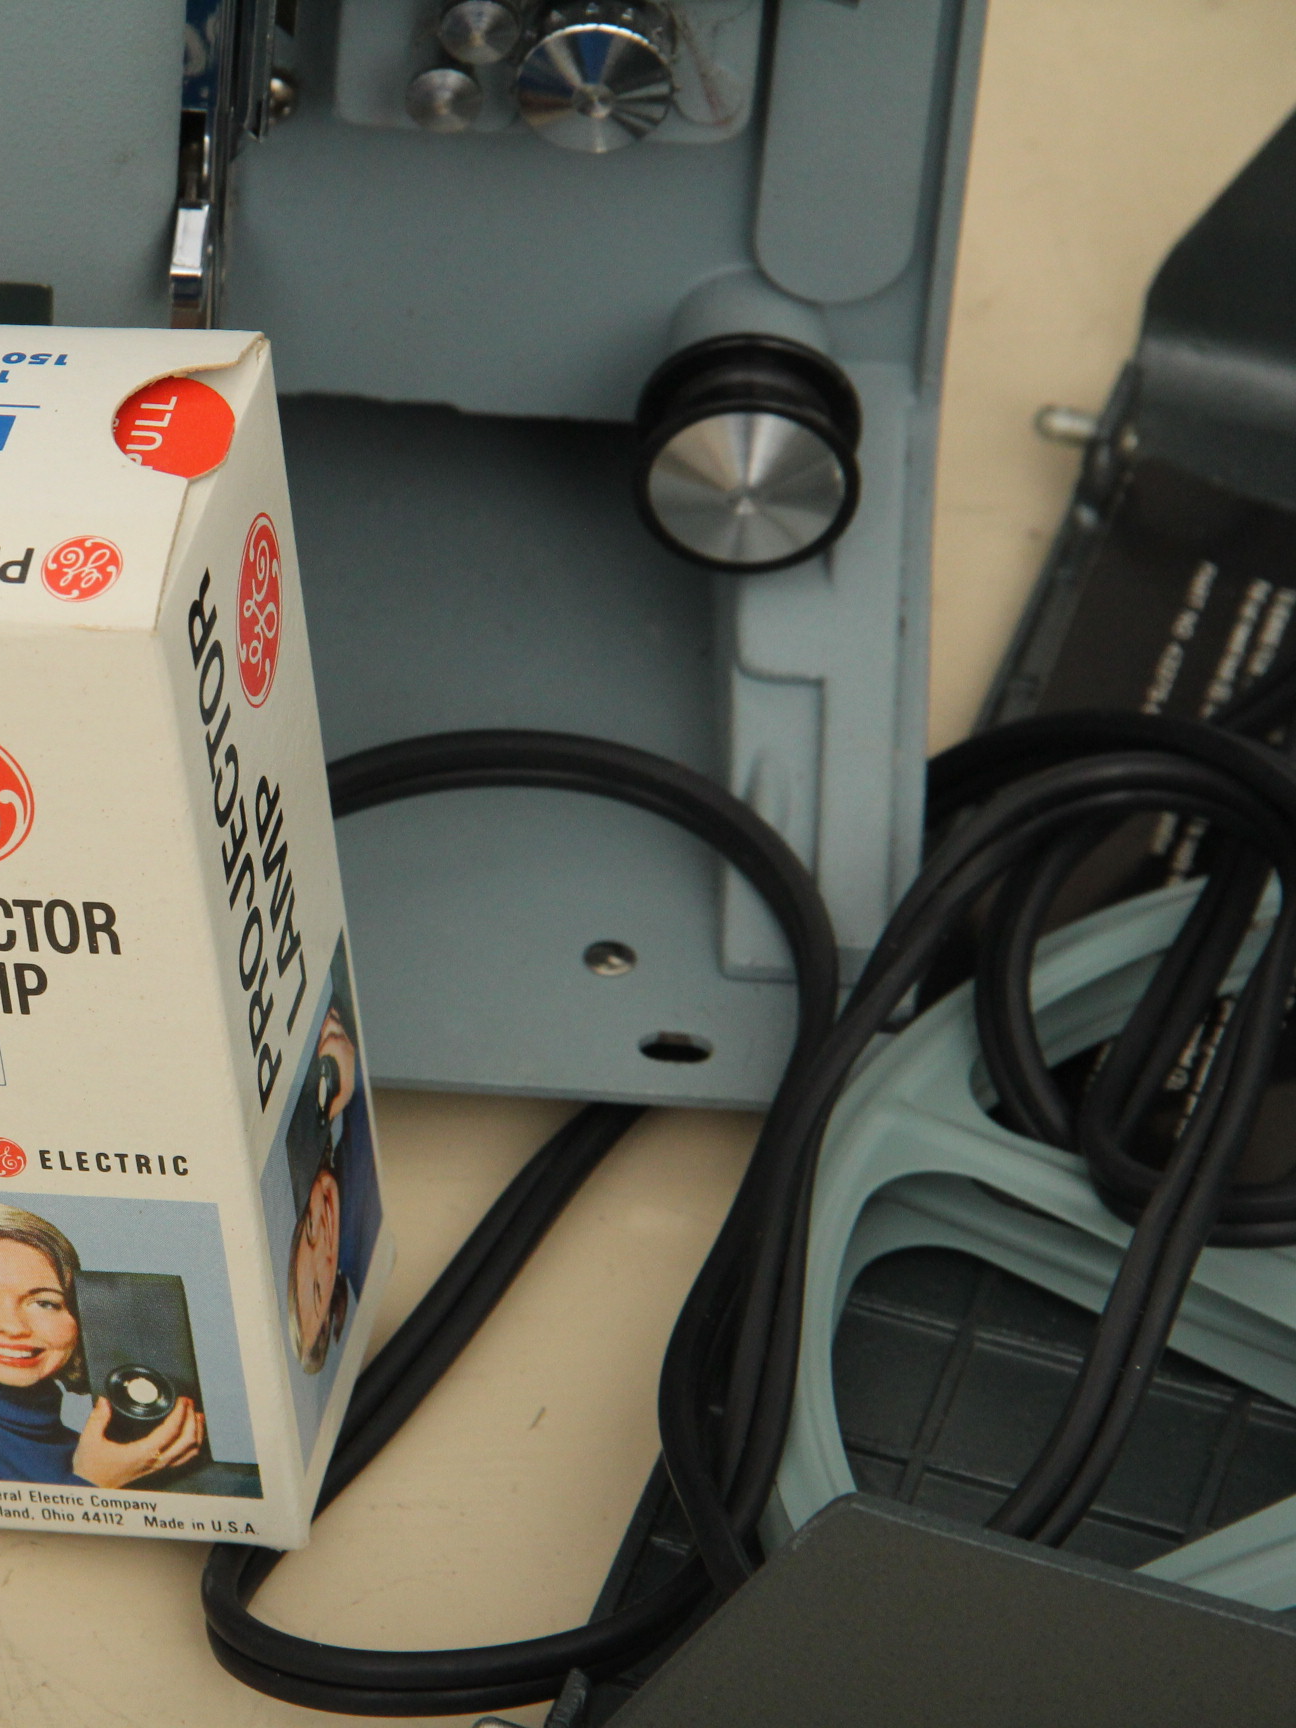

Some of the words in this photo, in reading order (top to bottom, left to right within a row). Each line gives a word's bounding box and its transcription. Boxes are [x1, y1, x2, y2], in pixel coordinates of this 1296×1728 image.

[1, 352, 69, 366] 150
[188, 570, 282, 1113] PROJECTOR
[254, 775, 307, 1036] LAMP
[38, 1149, 190, 1177] ELECTRIC
[28, 1489, 85, 1507] Electric
[90, 1495, 158, 1512] Company
[41, 1508, 76, 1523] Ohio
[81, 1510, 125, 1526] 44112
[143, 1515, 186, 1530] Made
[191, 1519, 206, 1532] in
[211, 1520, 261, 1536] U.S.A.
